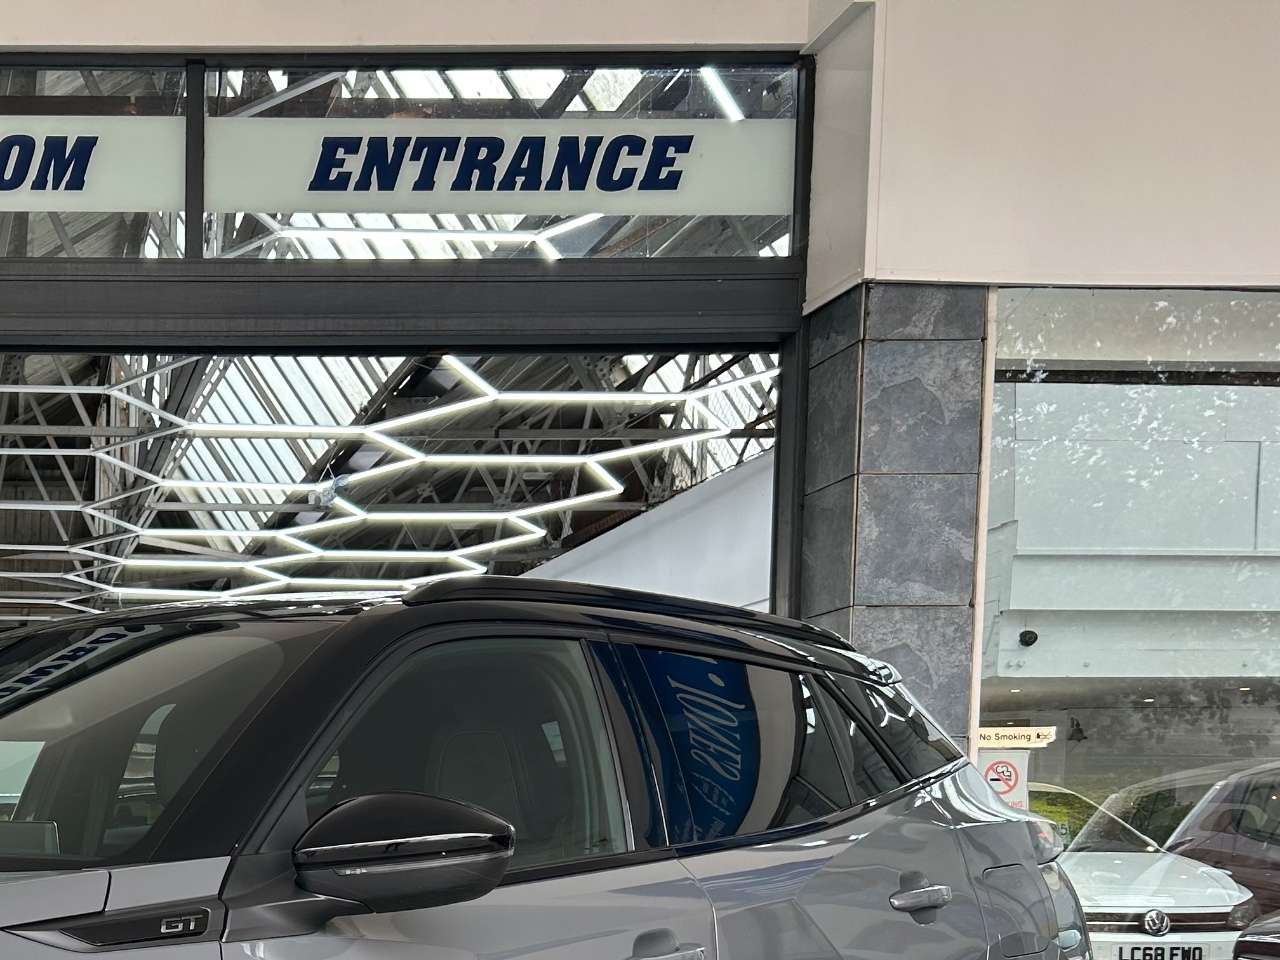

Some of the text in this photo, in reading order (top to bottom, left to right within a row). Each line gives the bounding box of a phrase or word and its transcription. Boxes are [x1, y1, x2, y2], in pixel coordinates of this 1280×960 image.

[307, 134, 695, 192] ENTRANCE
[979, 732, 1032, 742] No Smoking
[160, 914, 204, 934] GT
